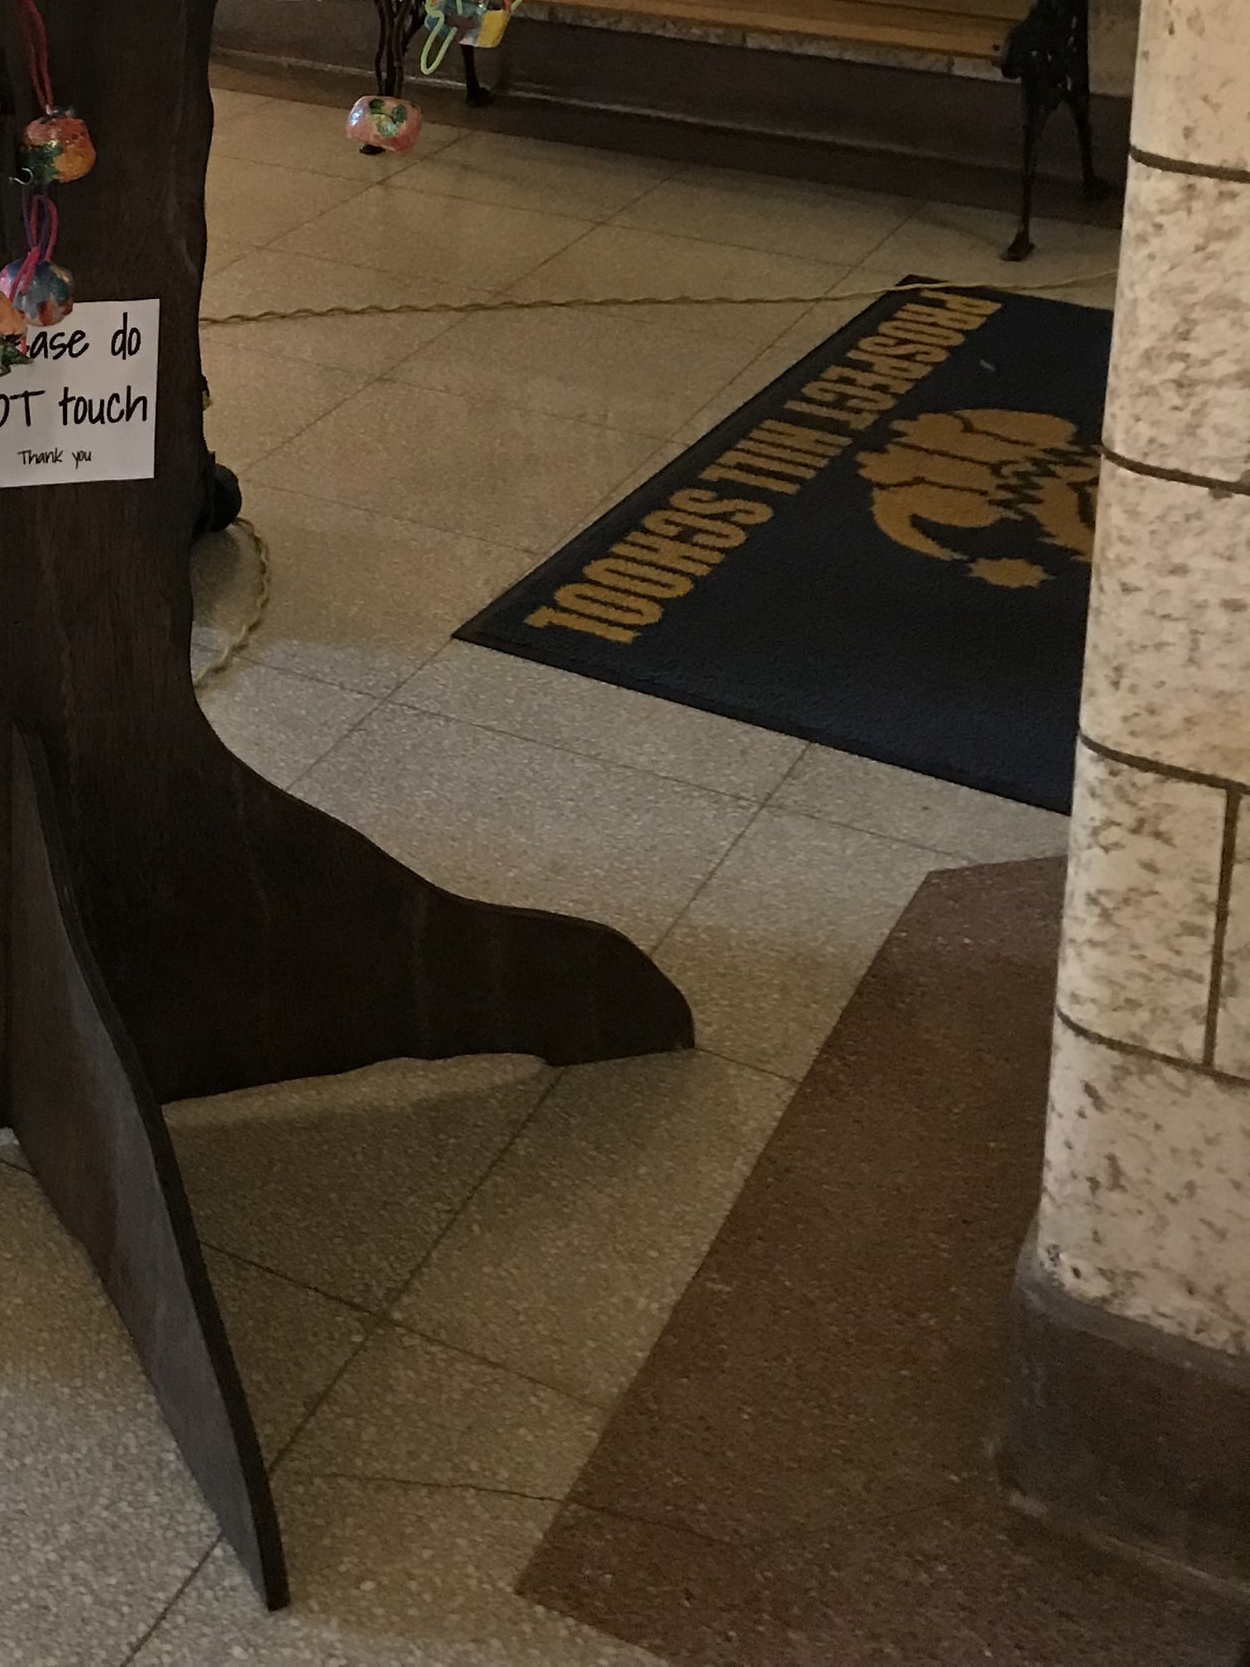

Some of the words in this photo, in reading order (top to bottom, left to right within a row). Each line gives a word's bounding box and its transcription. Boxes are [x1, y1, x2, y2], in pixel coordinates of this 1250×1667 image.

[111, 311, 142, 361] do
[785, 289, 1002, 431] PROSPECT
[58, 385, 148, 426] touch
[17, 448, 63, 465] Thank
[72, 449, 93, 469] you
[699, 419, 853, 495] HILL
[524, 487, 774, 644] SCHOOL
